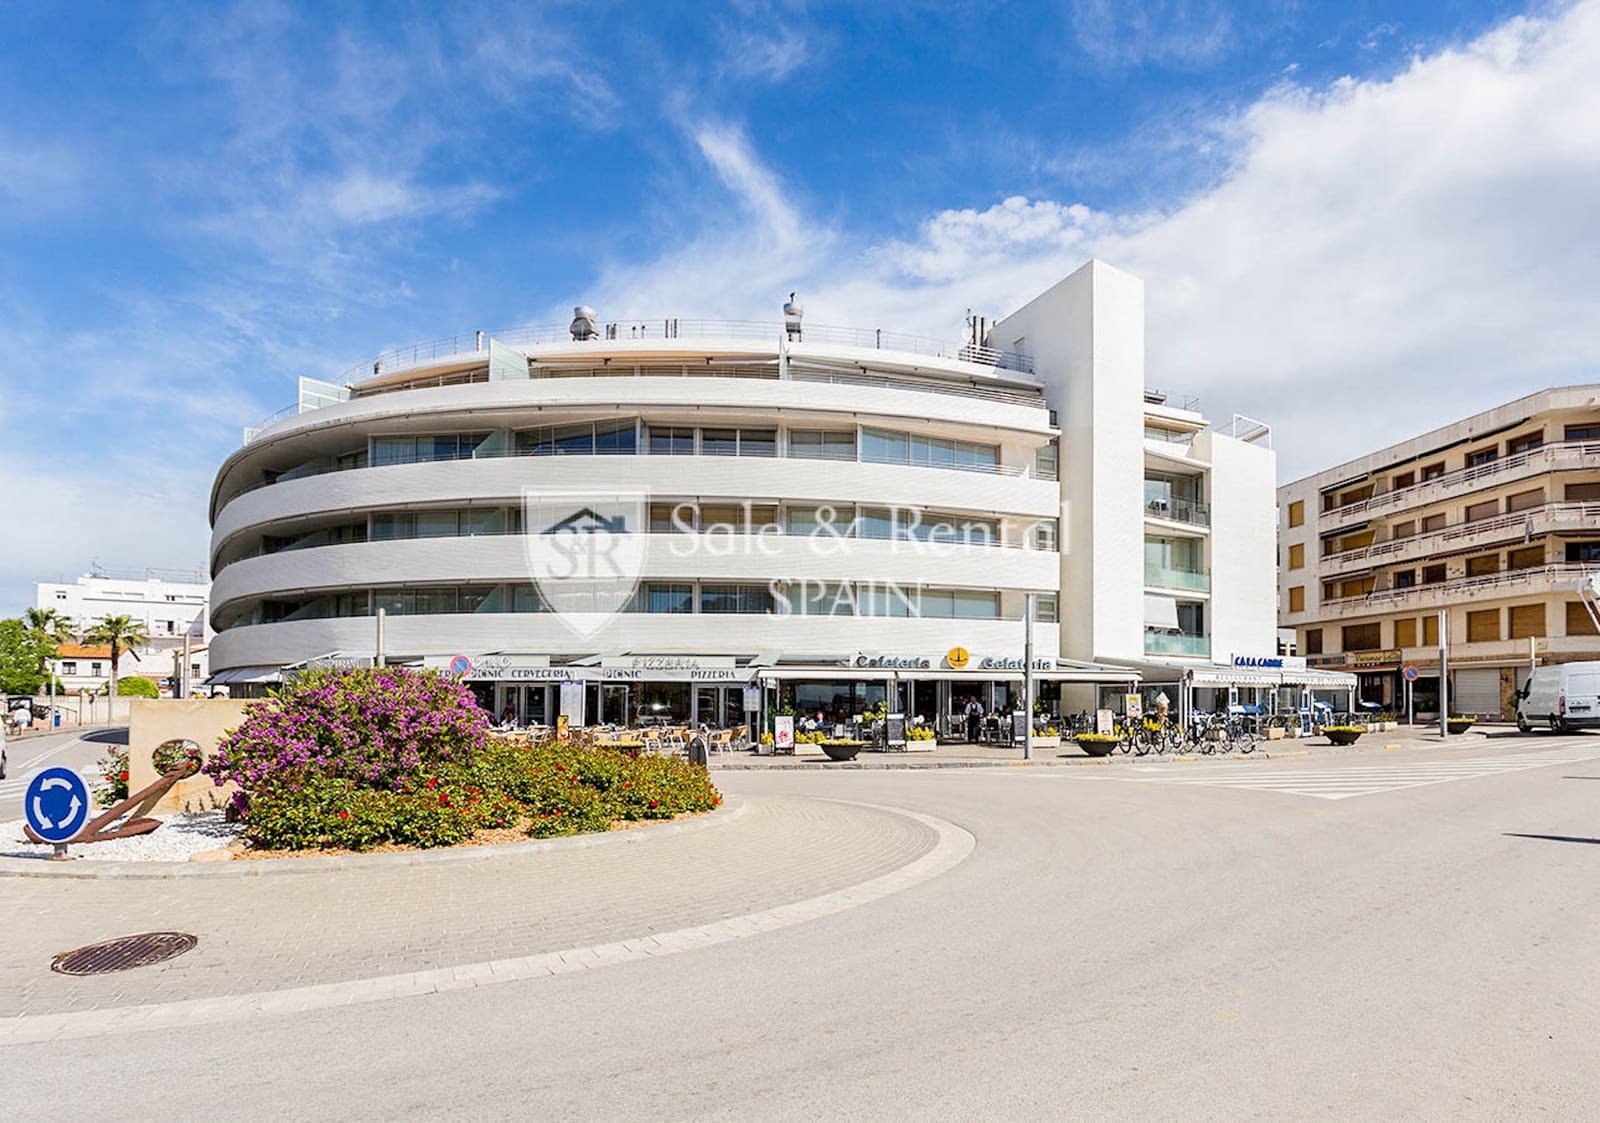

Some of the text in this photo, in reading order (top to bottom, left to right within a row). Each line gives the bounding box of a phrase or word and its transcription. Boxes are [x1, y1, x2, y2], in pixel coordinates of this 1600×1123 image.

[983, 656, 1051, 669] Gelatria
[511, 667, 570, 681] CERVECERIA
[690, 669, 736, 680] PIZZERIA
